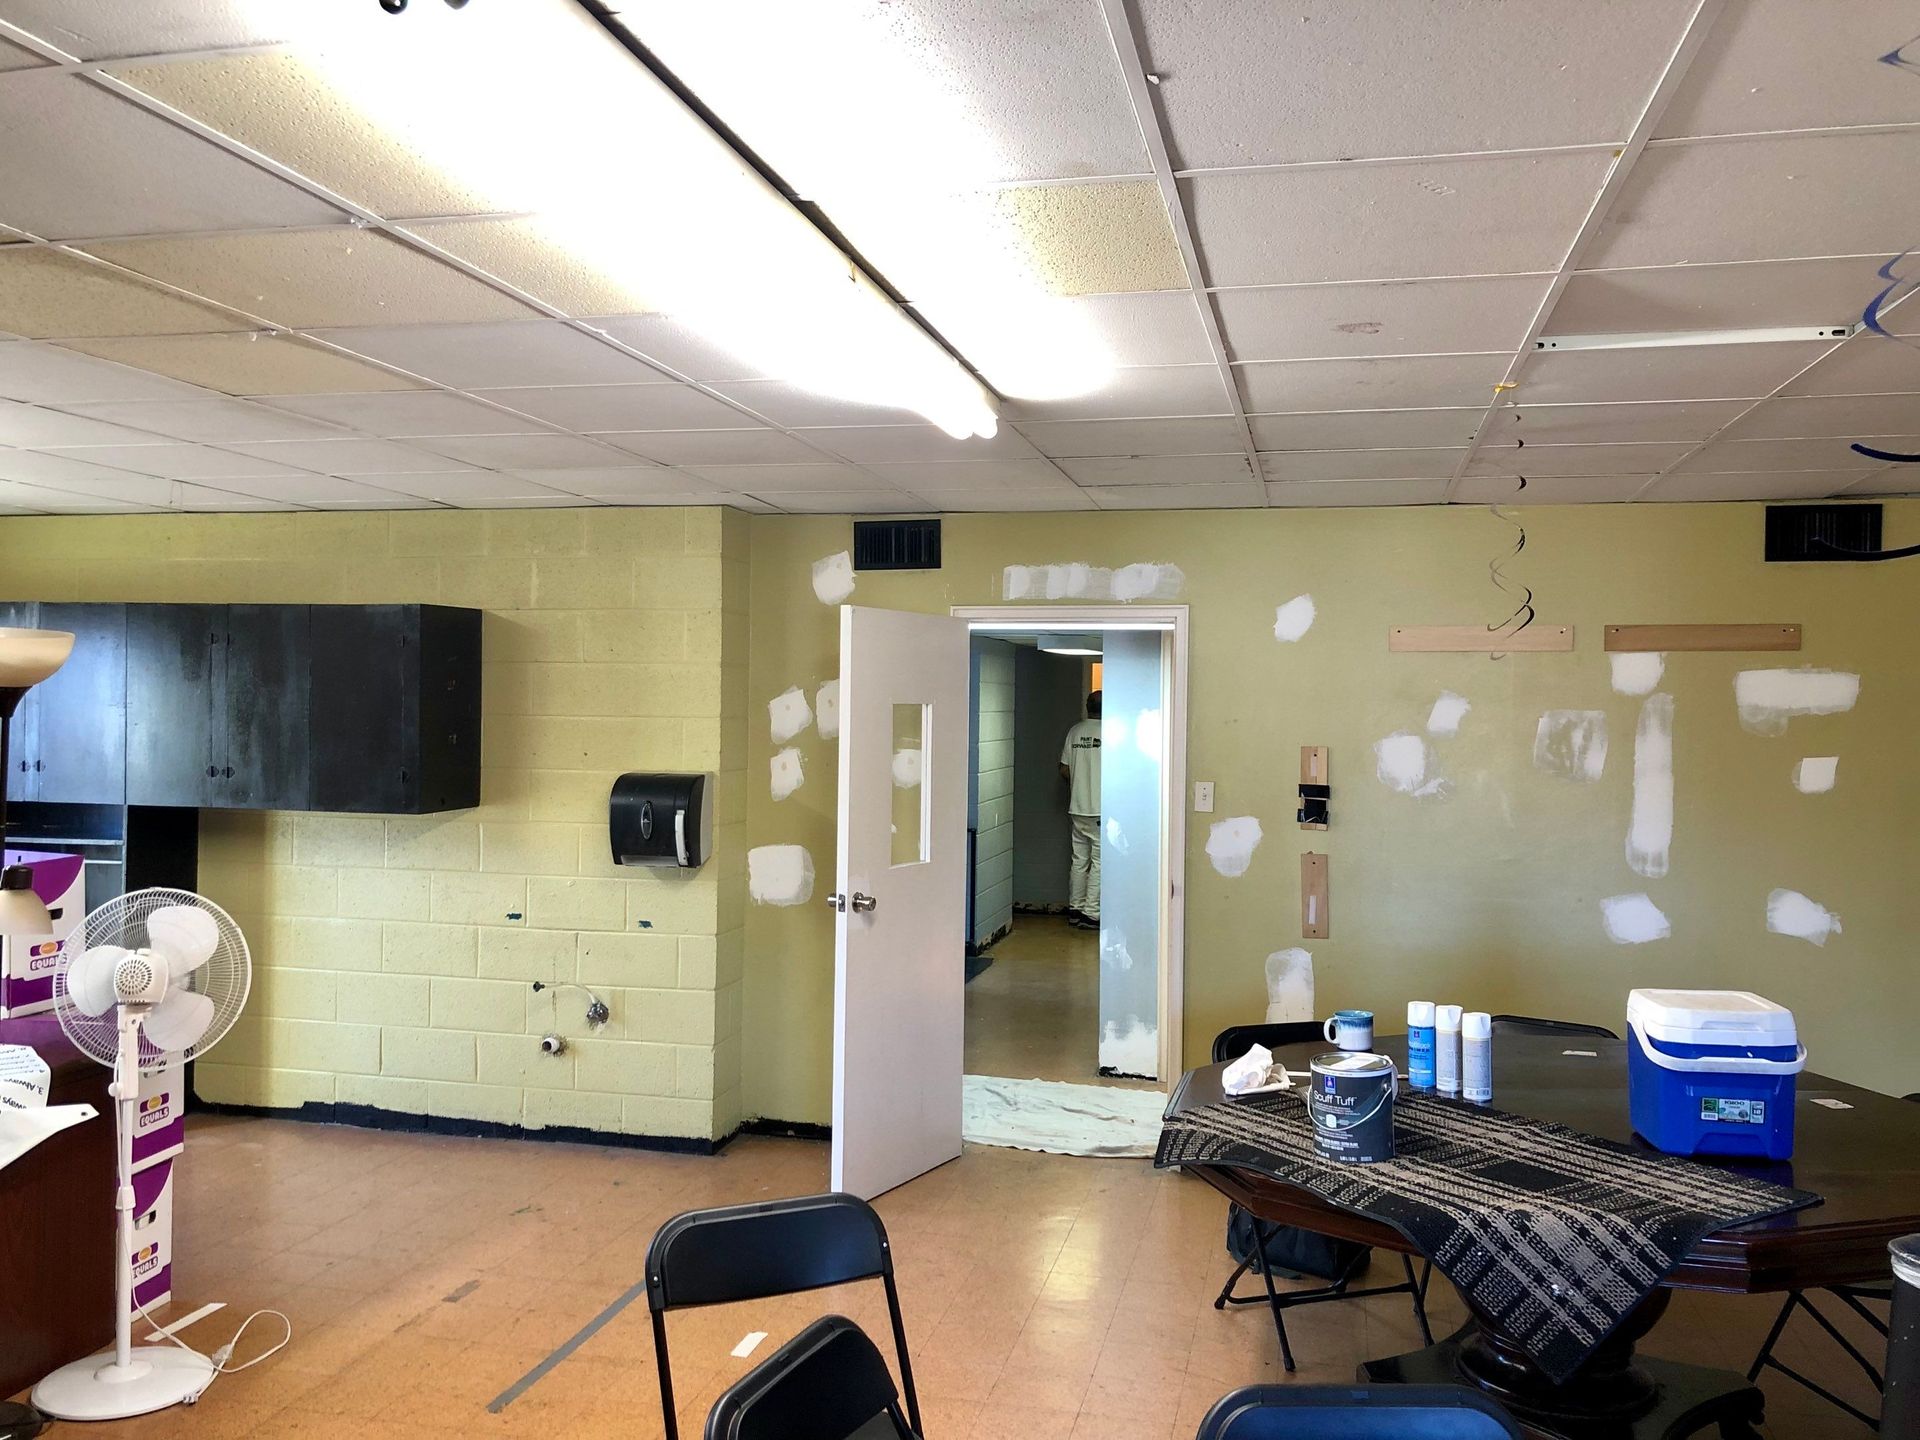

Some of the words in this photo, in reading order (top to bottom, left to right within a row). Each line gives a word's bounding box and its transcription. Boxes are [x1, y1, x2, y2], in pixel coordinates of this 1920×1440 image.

[1313, 1090, 1333, 1104] Scuff
[1334, 1095, 1355, 1106] Tuff
[140, 1107, 169, 1127] EQUALS
